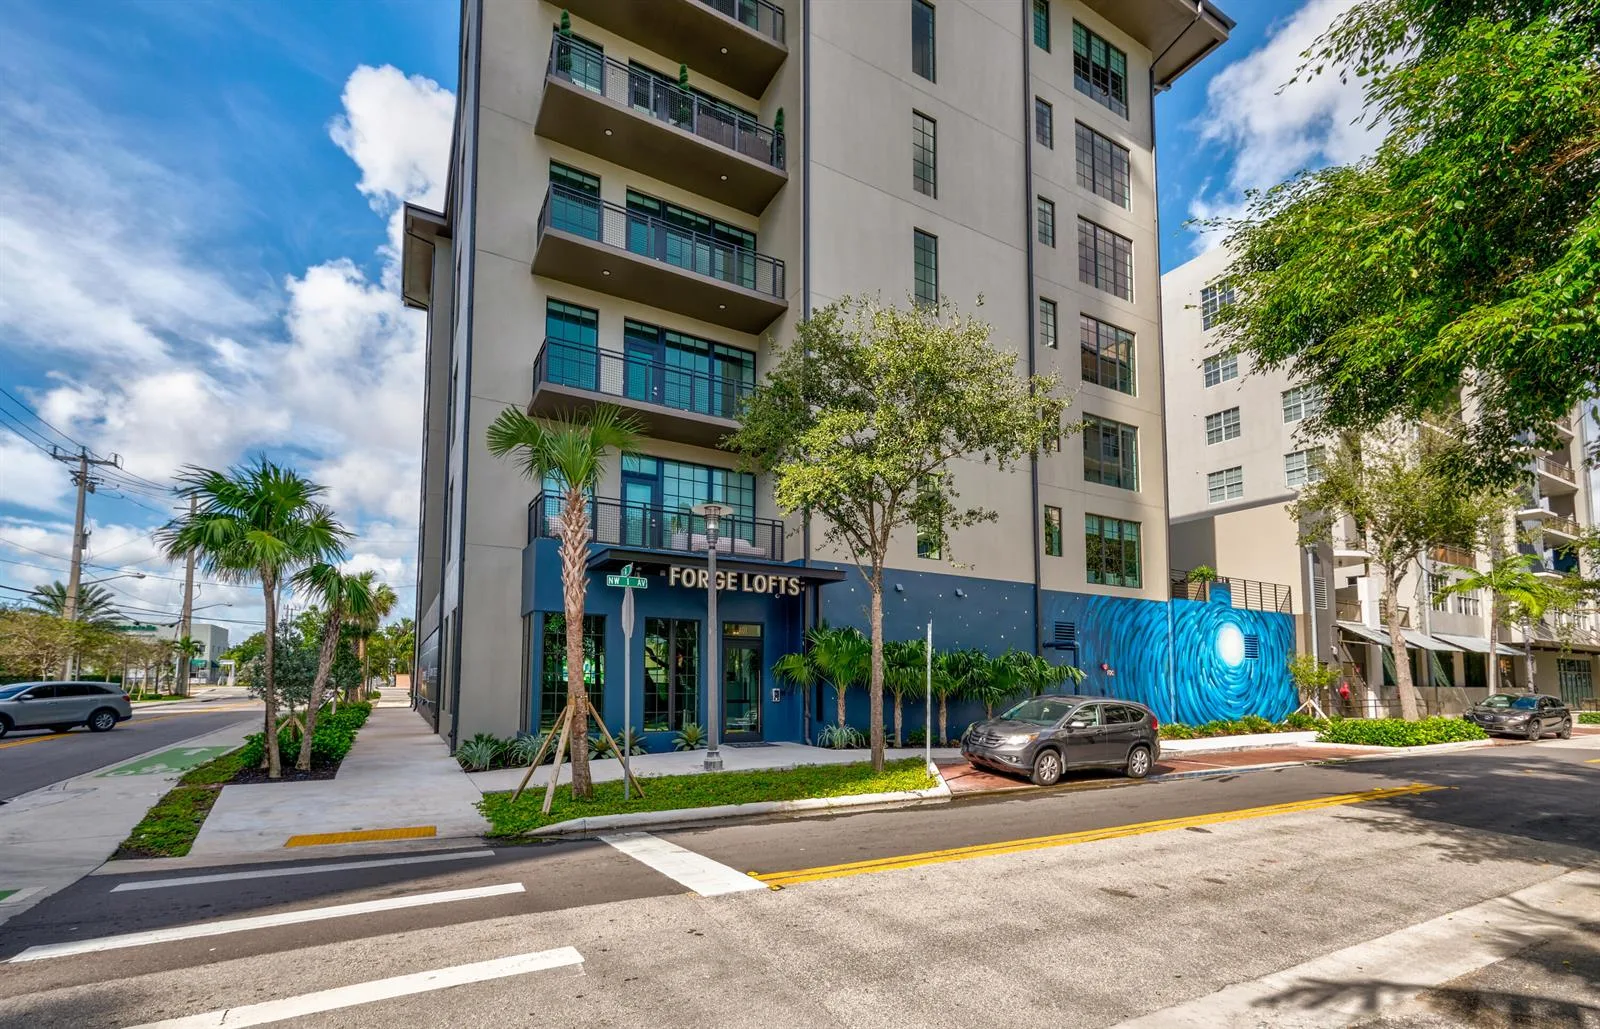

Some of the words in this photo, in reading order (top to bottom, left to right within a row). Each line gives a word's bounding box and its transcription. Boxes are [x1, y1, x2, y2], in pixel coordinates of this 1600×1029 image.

[608, 577, 620, 585] NW
[637, 579, 646, 587] AV
[669, 566, 737, 590] FORGE
[743, 573, 800, 596] LOFTS
